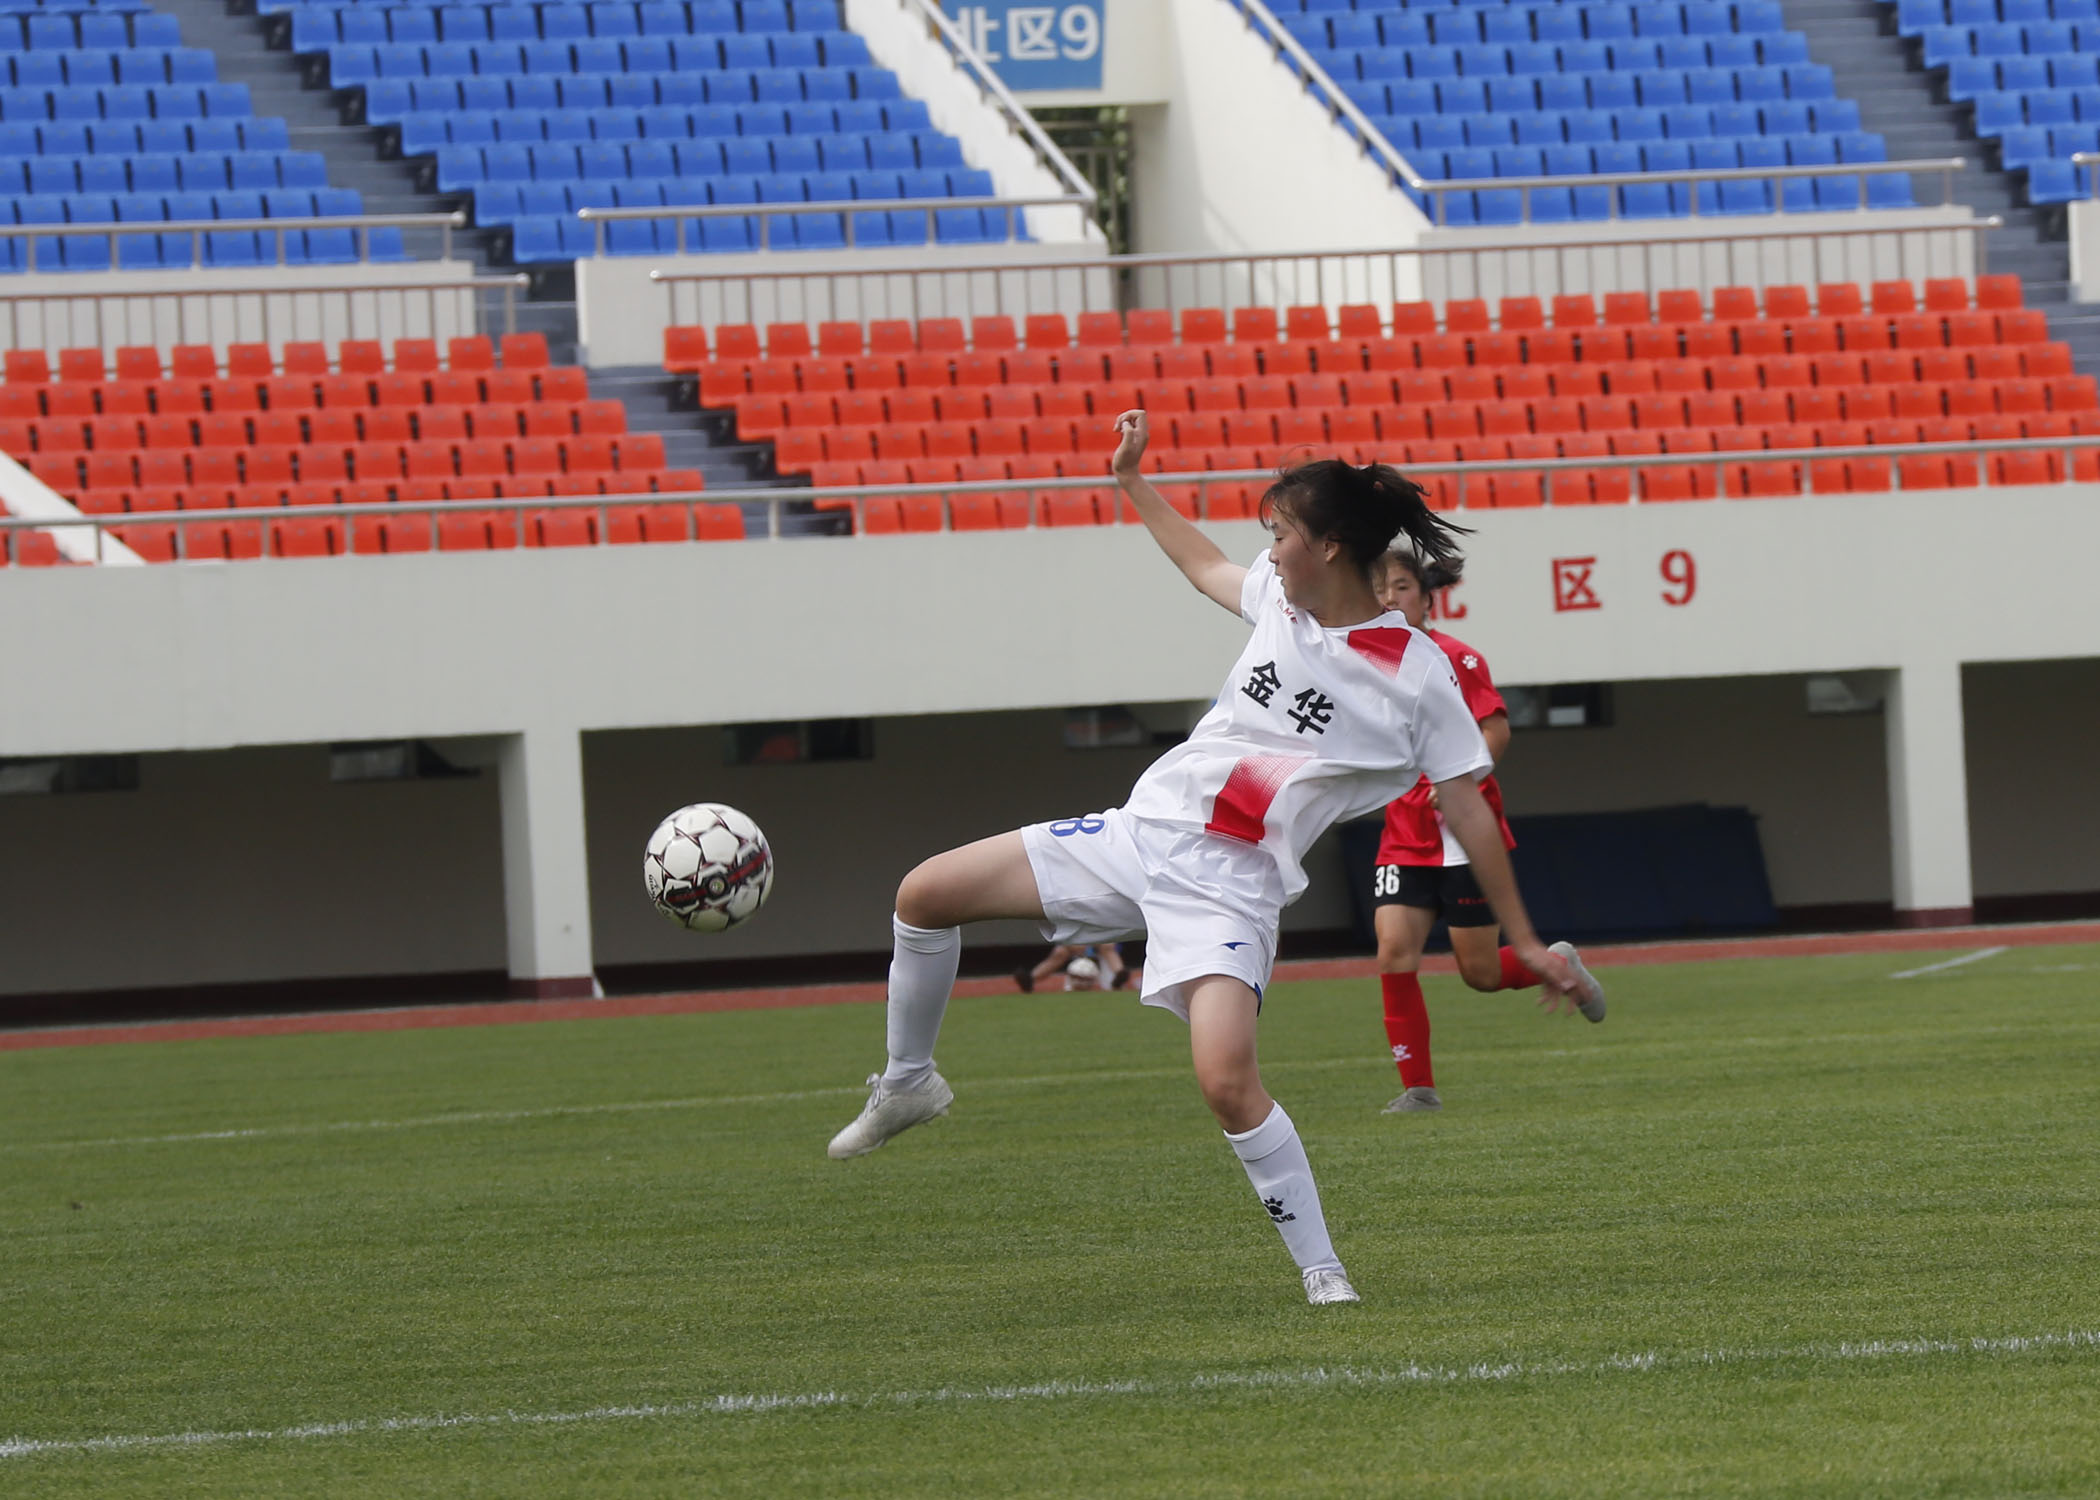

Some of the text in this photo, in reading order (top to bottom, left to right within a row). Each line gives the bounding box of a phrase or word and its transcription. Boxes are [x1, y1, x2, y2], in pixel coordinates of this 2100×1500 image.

[1240, 660, 1334, 735] 金华
[1049, 818, 1105, 837] 8
[1374, 863, 1400, 898] 36
